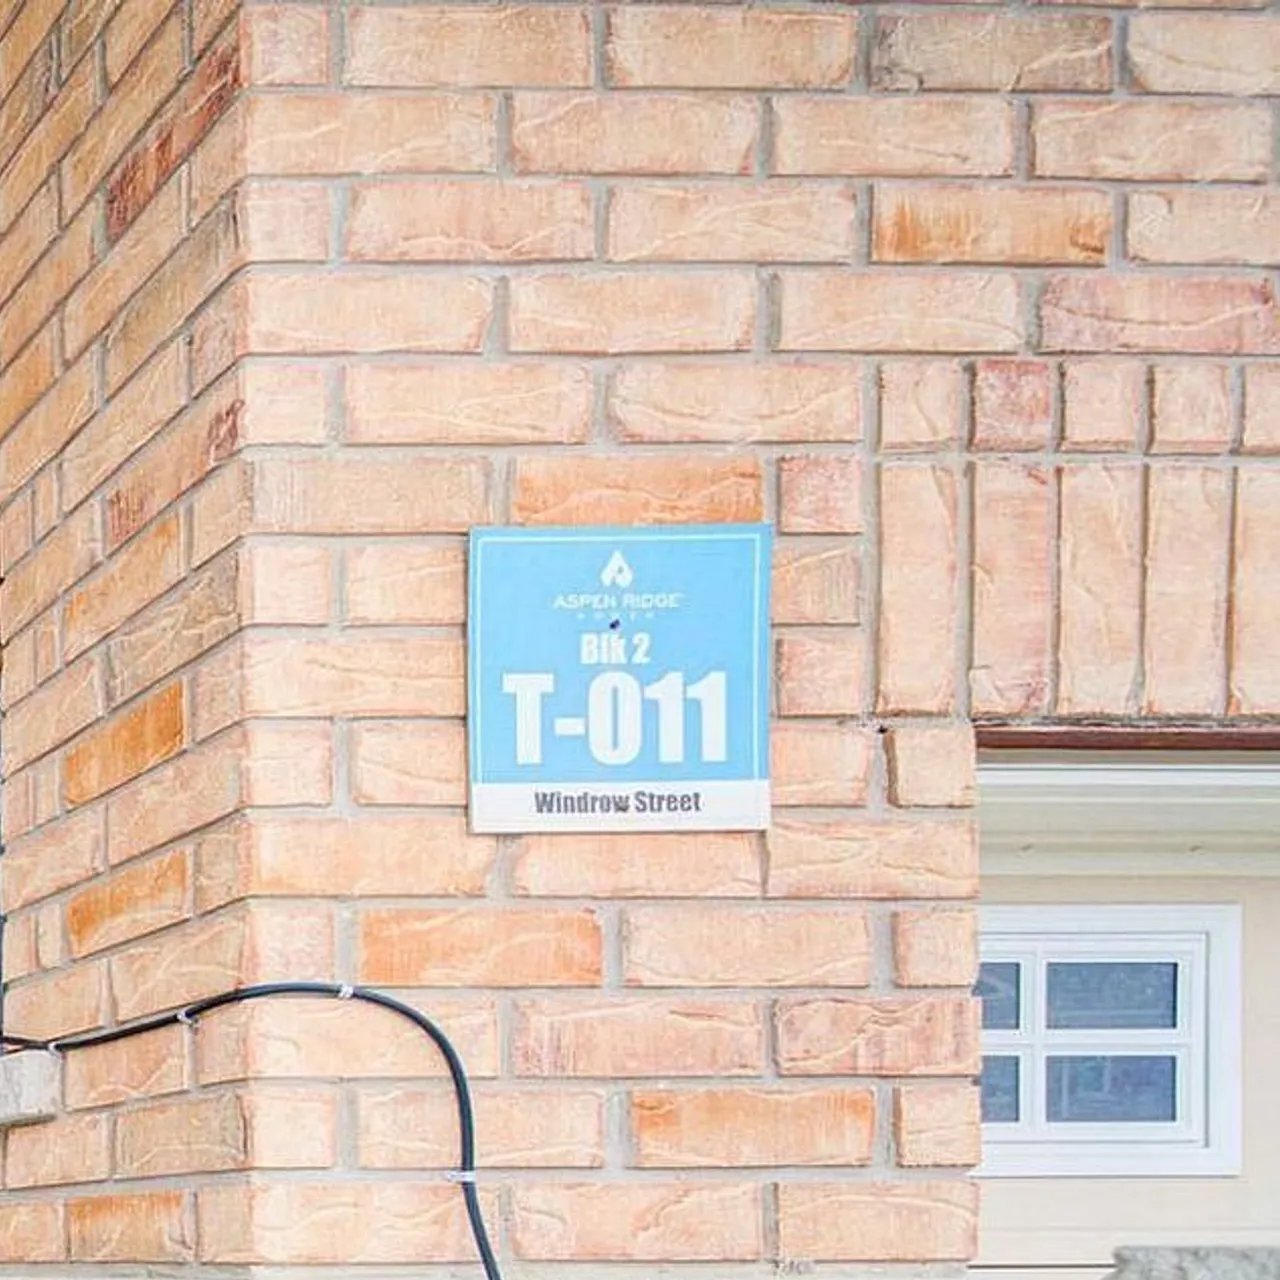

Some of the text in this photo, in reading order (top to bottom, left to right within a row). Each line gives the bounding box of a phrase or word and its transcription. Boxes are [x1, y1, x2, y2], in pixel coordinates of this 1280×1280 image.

[552, 592, 684, 609] ASPEN RIDGE
[580, 632, 652, 665] Blk 2
[502, 670, 728, 766] T-011
[534, 790, 701, 814] Windrow Street
